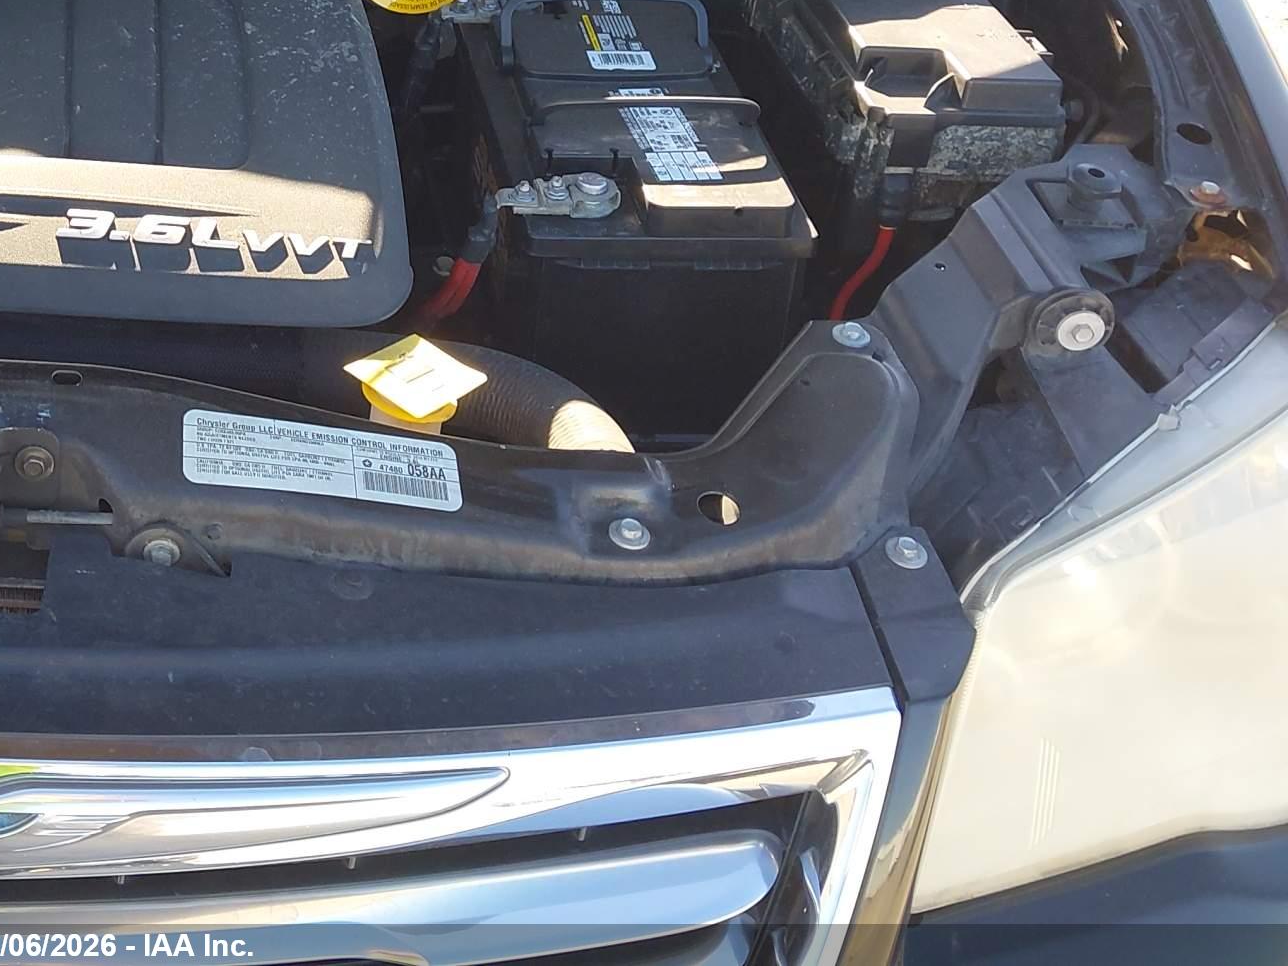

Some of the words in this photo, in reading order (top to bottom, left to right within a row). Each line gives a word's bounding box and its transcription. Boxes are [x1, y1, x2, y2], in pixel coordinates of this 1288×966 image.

[197, 417, 229, 429] Chrysler
[232, 422, 255, 433] Group
[258, 425, 273, 434] LLC
[277, 427, 308, 438] VEHICLE
[311, 431, 349, 444] EMISSION
[352, 437, 387, 449] CONTROL
[389, 443, 443, 457] INFORMATION
